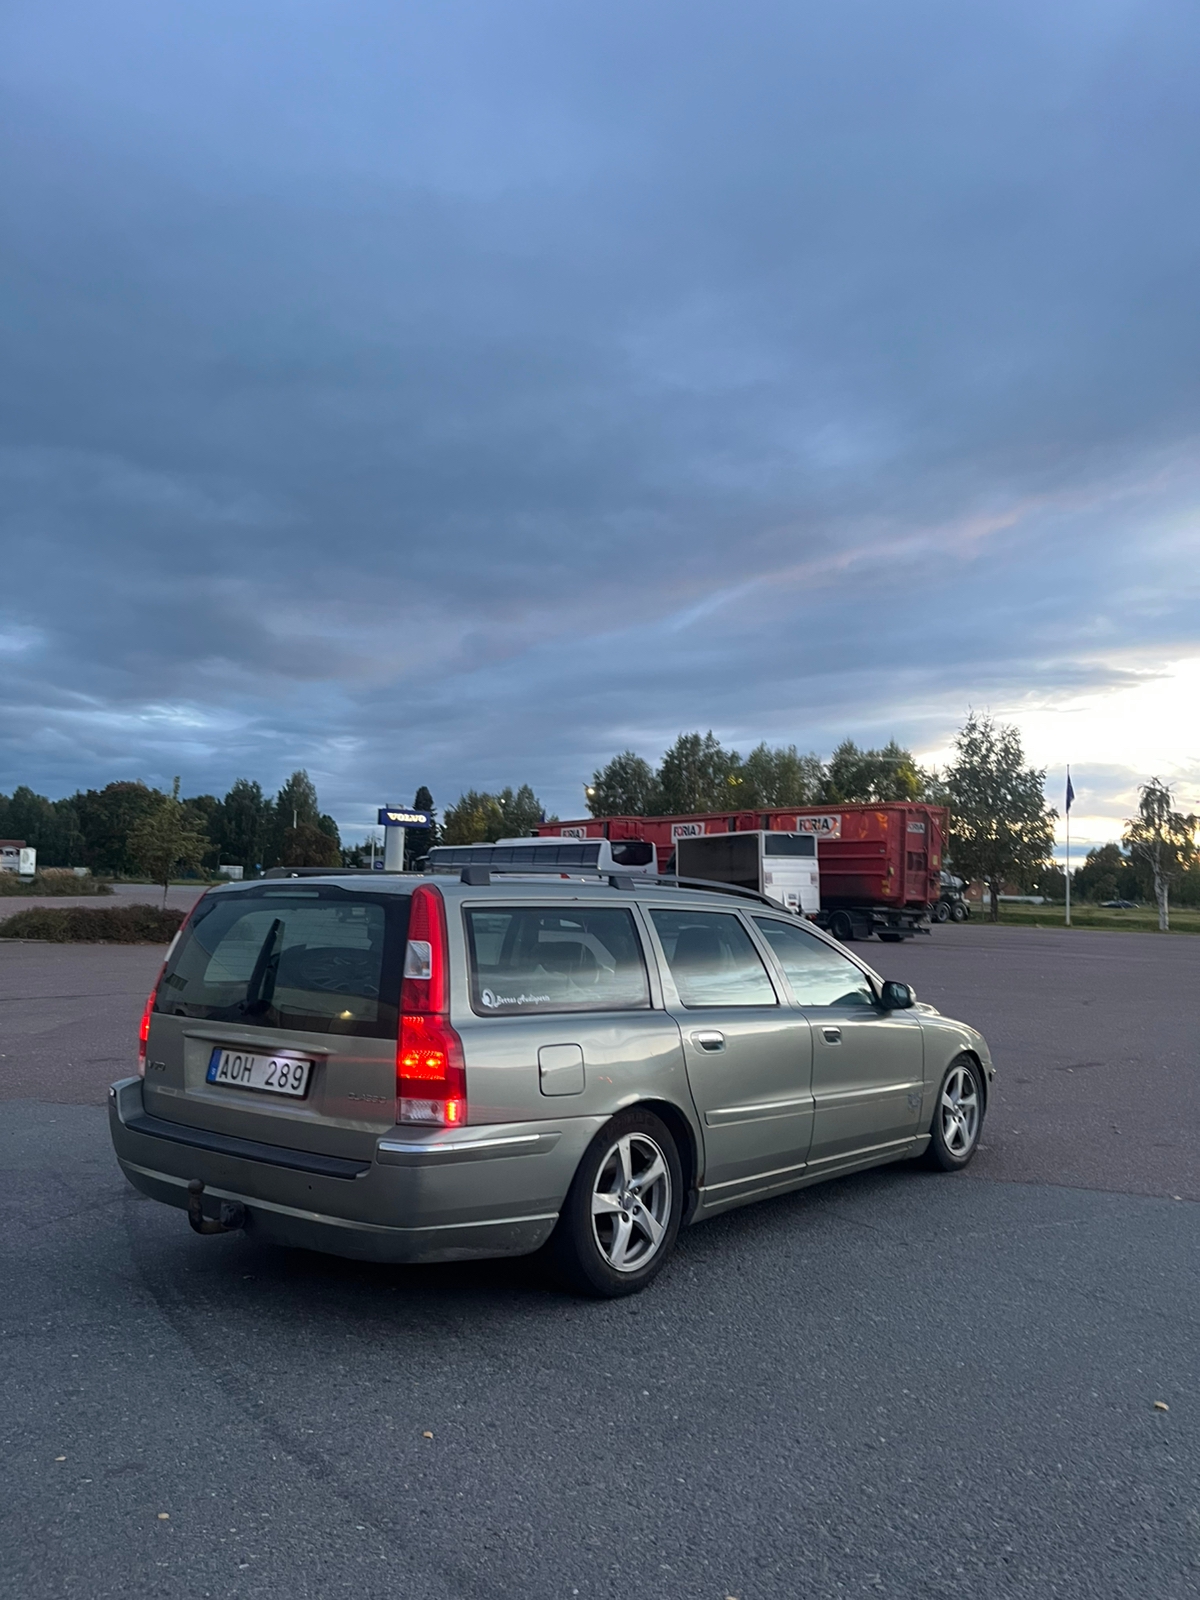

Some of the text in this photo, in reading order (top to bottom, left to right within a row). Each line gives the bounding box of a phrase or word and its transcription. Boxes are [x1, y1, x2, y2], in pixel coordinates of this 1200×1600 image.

[386, 812, 427, 823] VOLVO
[673, 824, 697, 837] FORIA
[800, 818, 830, 831] FORIA
[219, 1053, 304, 1090] AOH 289
